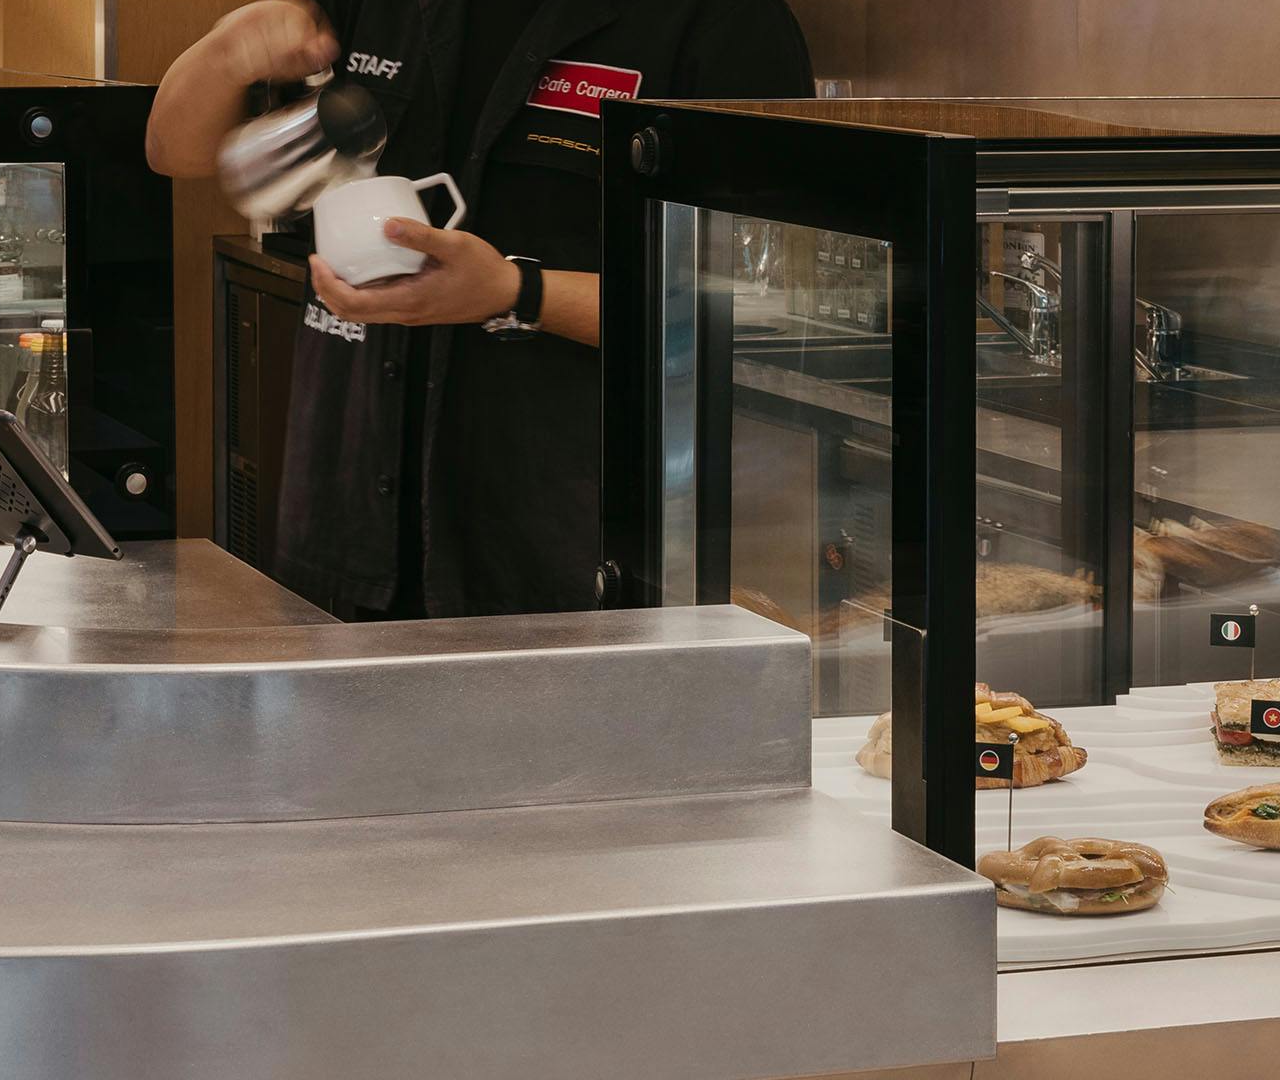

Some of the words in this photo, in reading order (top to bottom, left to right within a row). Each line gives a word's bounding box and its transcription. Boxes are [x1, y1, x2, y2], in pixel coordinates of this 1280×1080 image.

[346, 52, 403, 80] STAFF
[538, 76, 571, 93] Cafe
[527, 134, 600, 156] PORSCH
